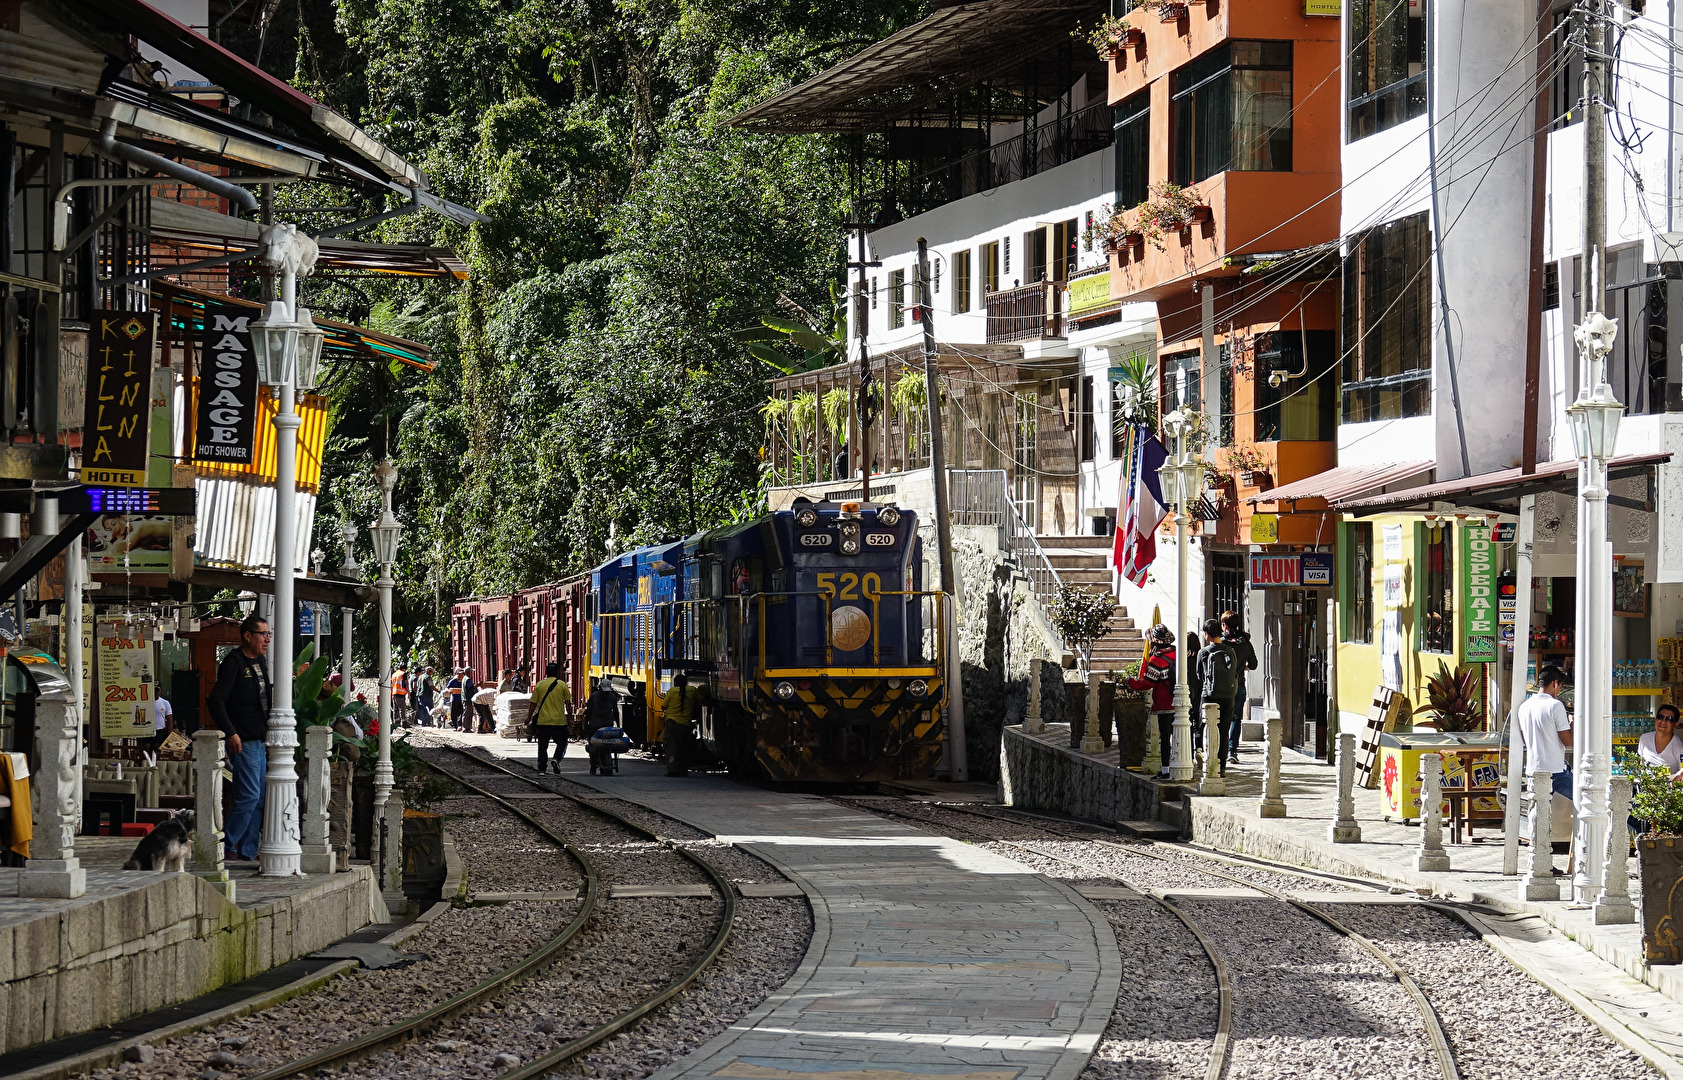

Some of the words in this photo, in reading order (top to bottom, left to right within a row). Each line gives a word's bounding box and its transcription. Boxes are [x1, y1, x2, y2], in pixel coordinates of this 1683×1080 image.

[208, 315, 250, 444] MASSAGE
[93, 319, 119, 462] KILLA
[118, 350, 140, 438] INN
[198, 444, 213, 456] HOT
[215, 446, 246, 458] SHOWER
[88, 472, 138, 484] HOTEL
[86, 489, 160, 512] TIME
[804, 535, 826, 544] 520
[870, 535, 890, 544] 520
[816, 572, 881, 600] 520
[1469, 528, 1491, 632] HOSPEDAJE
[102, 633, 145, 650] 4x1
[105, 684, 148, 702] 2x1
